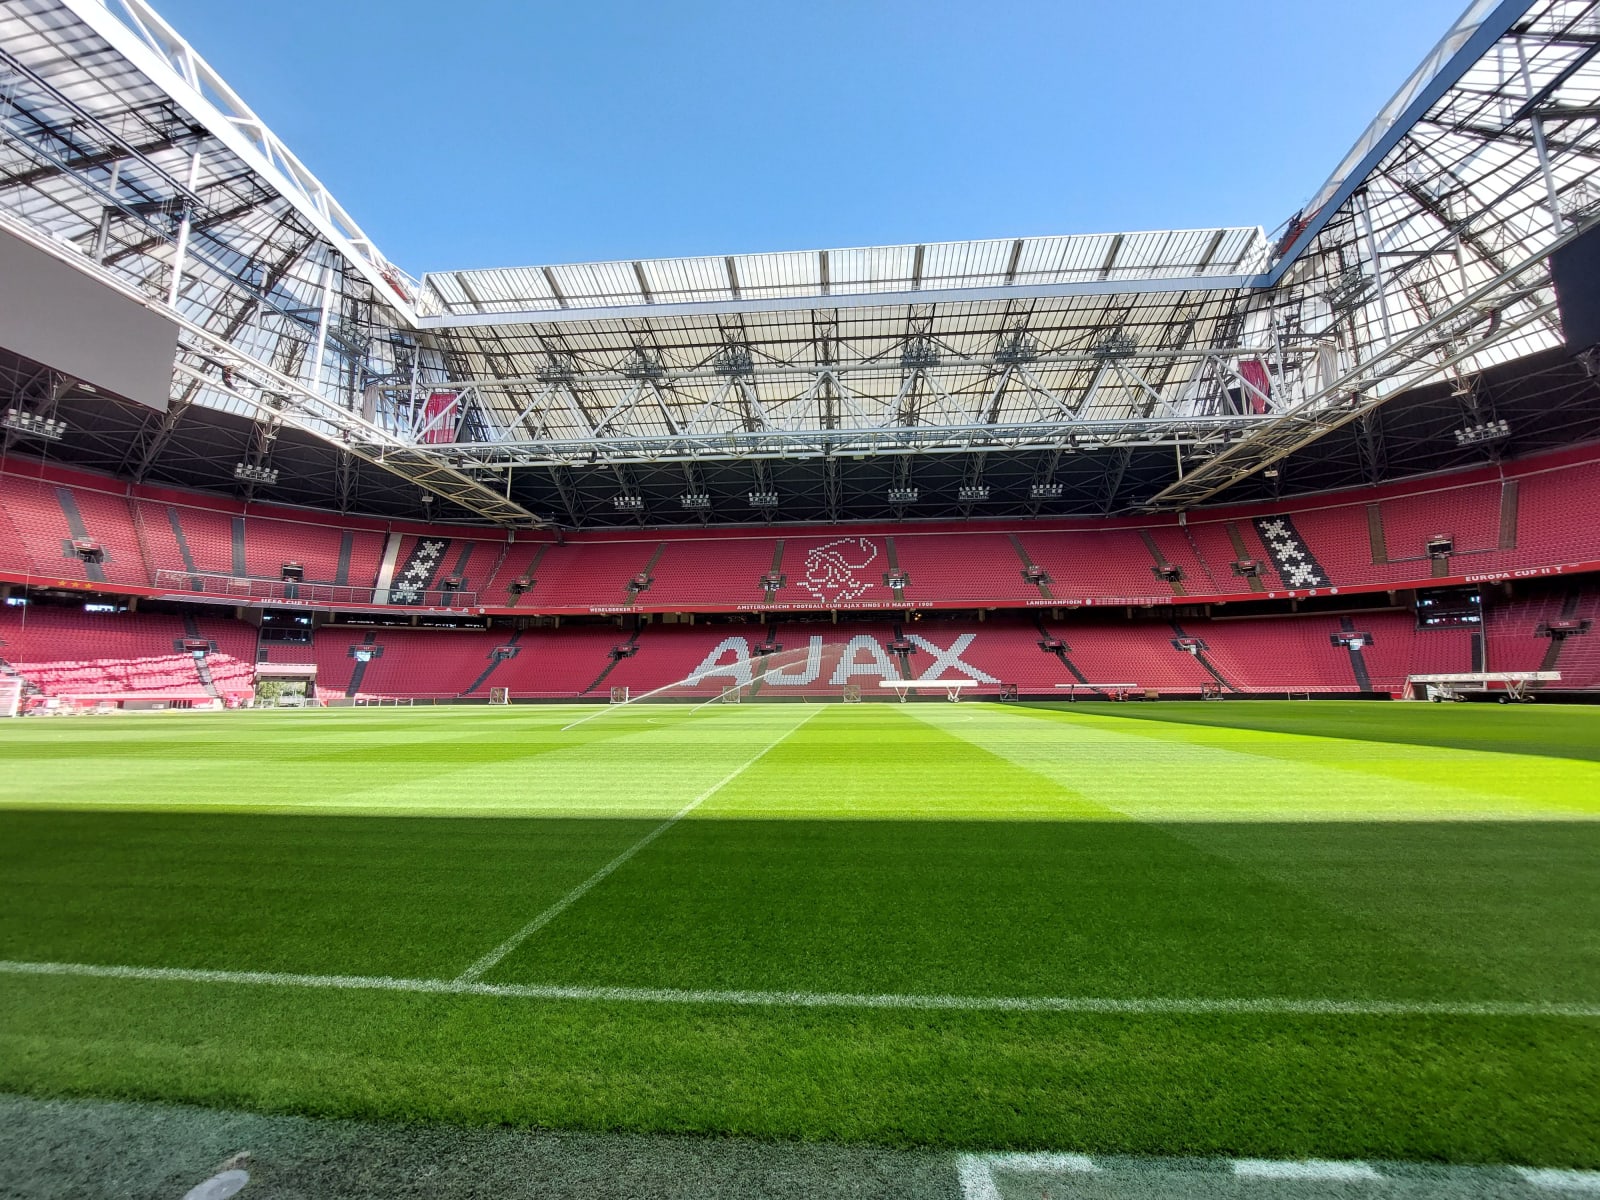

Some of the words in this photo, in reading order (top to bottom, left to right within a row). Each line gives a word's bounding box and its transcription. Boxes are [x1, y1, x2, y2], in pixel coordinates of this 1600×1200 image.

[1465, 573, 1510, 582] EUROPA
[1514, 569, 1537, 577] CUP
[680, 633, 1002, 687] AJAX
